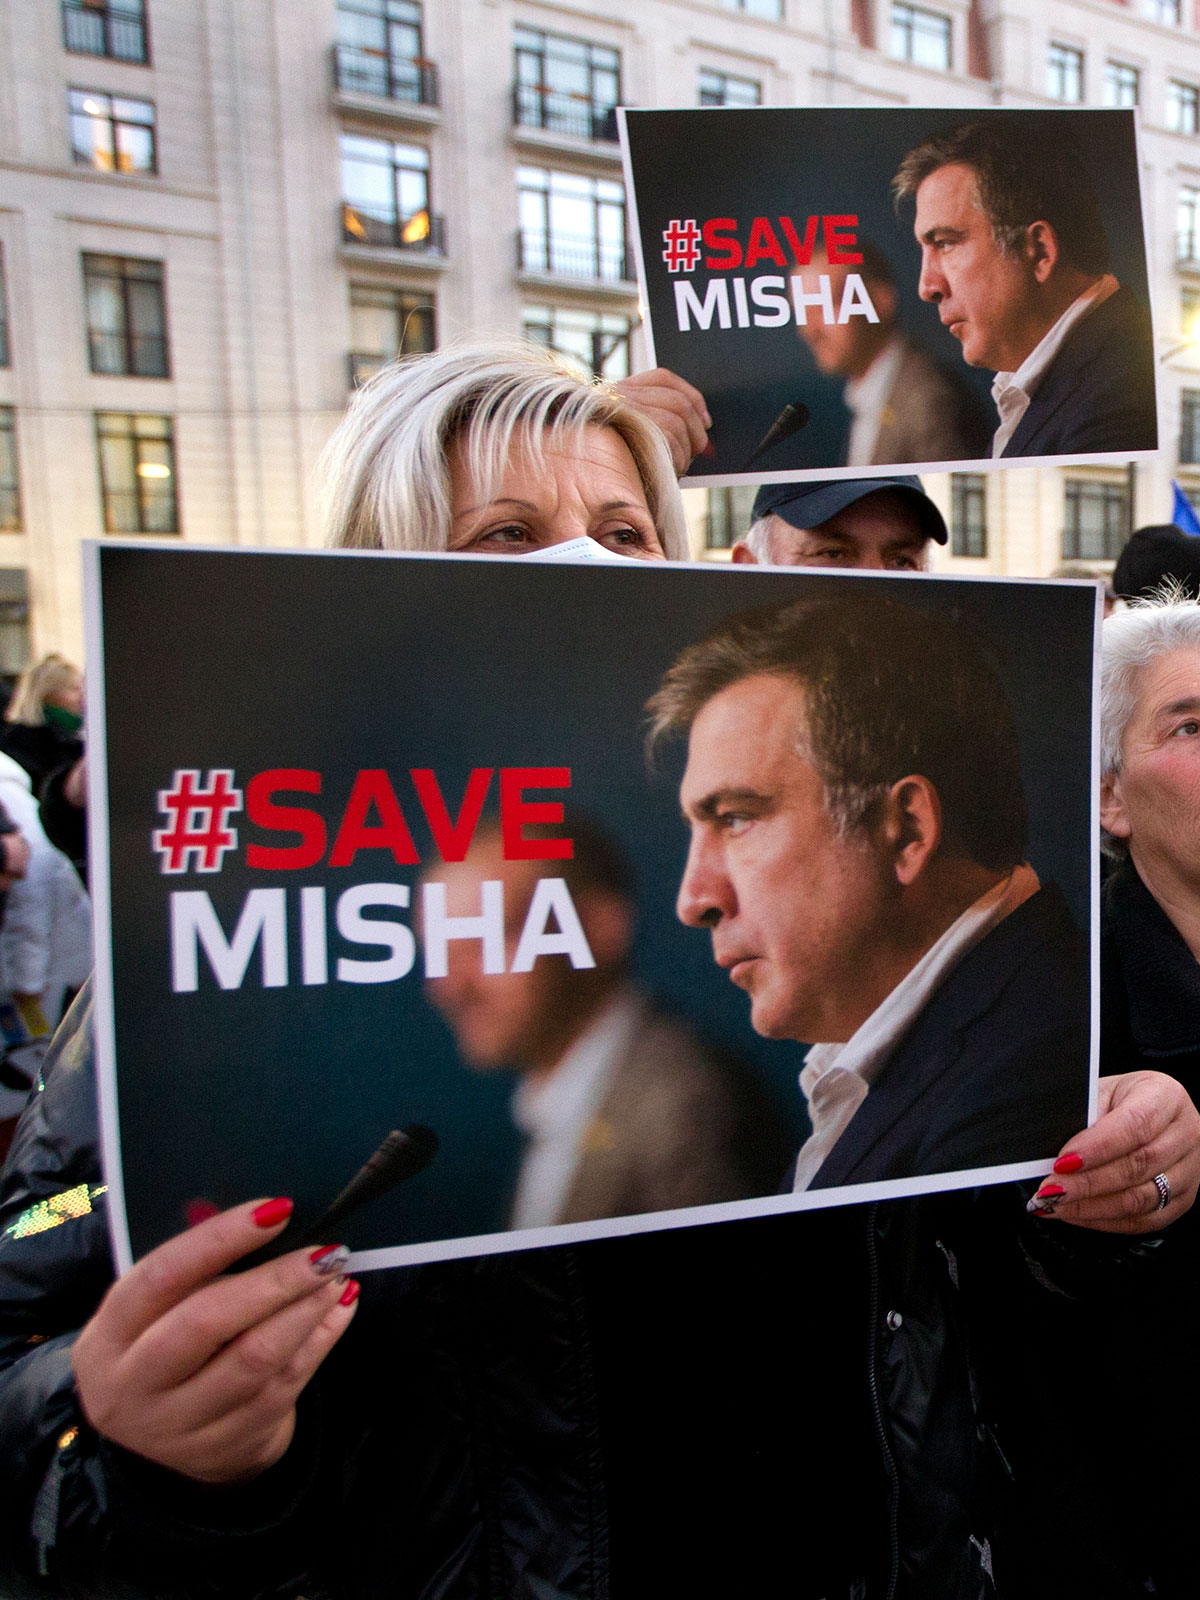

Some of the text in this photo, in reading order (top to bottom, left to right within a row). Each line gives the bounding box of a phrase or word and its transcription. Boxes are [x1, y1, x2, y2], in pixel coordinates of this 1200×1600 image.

[662, 214, 864, 273] #SAVE
[673, 273, 880, 332] MISHA
[152, 767, 574, 874] #SAVE
[170, 877, 597, 993] MISHA
